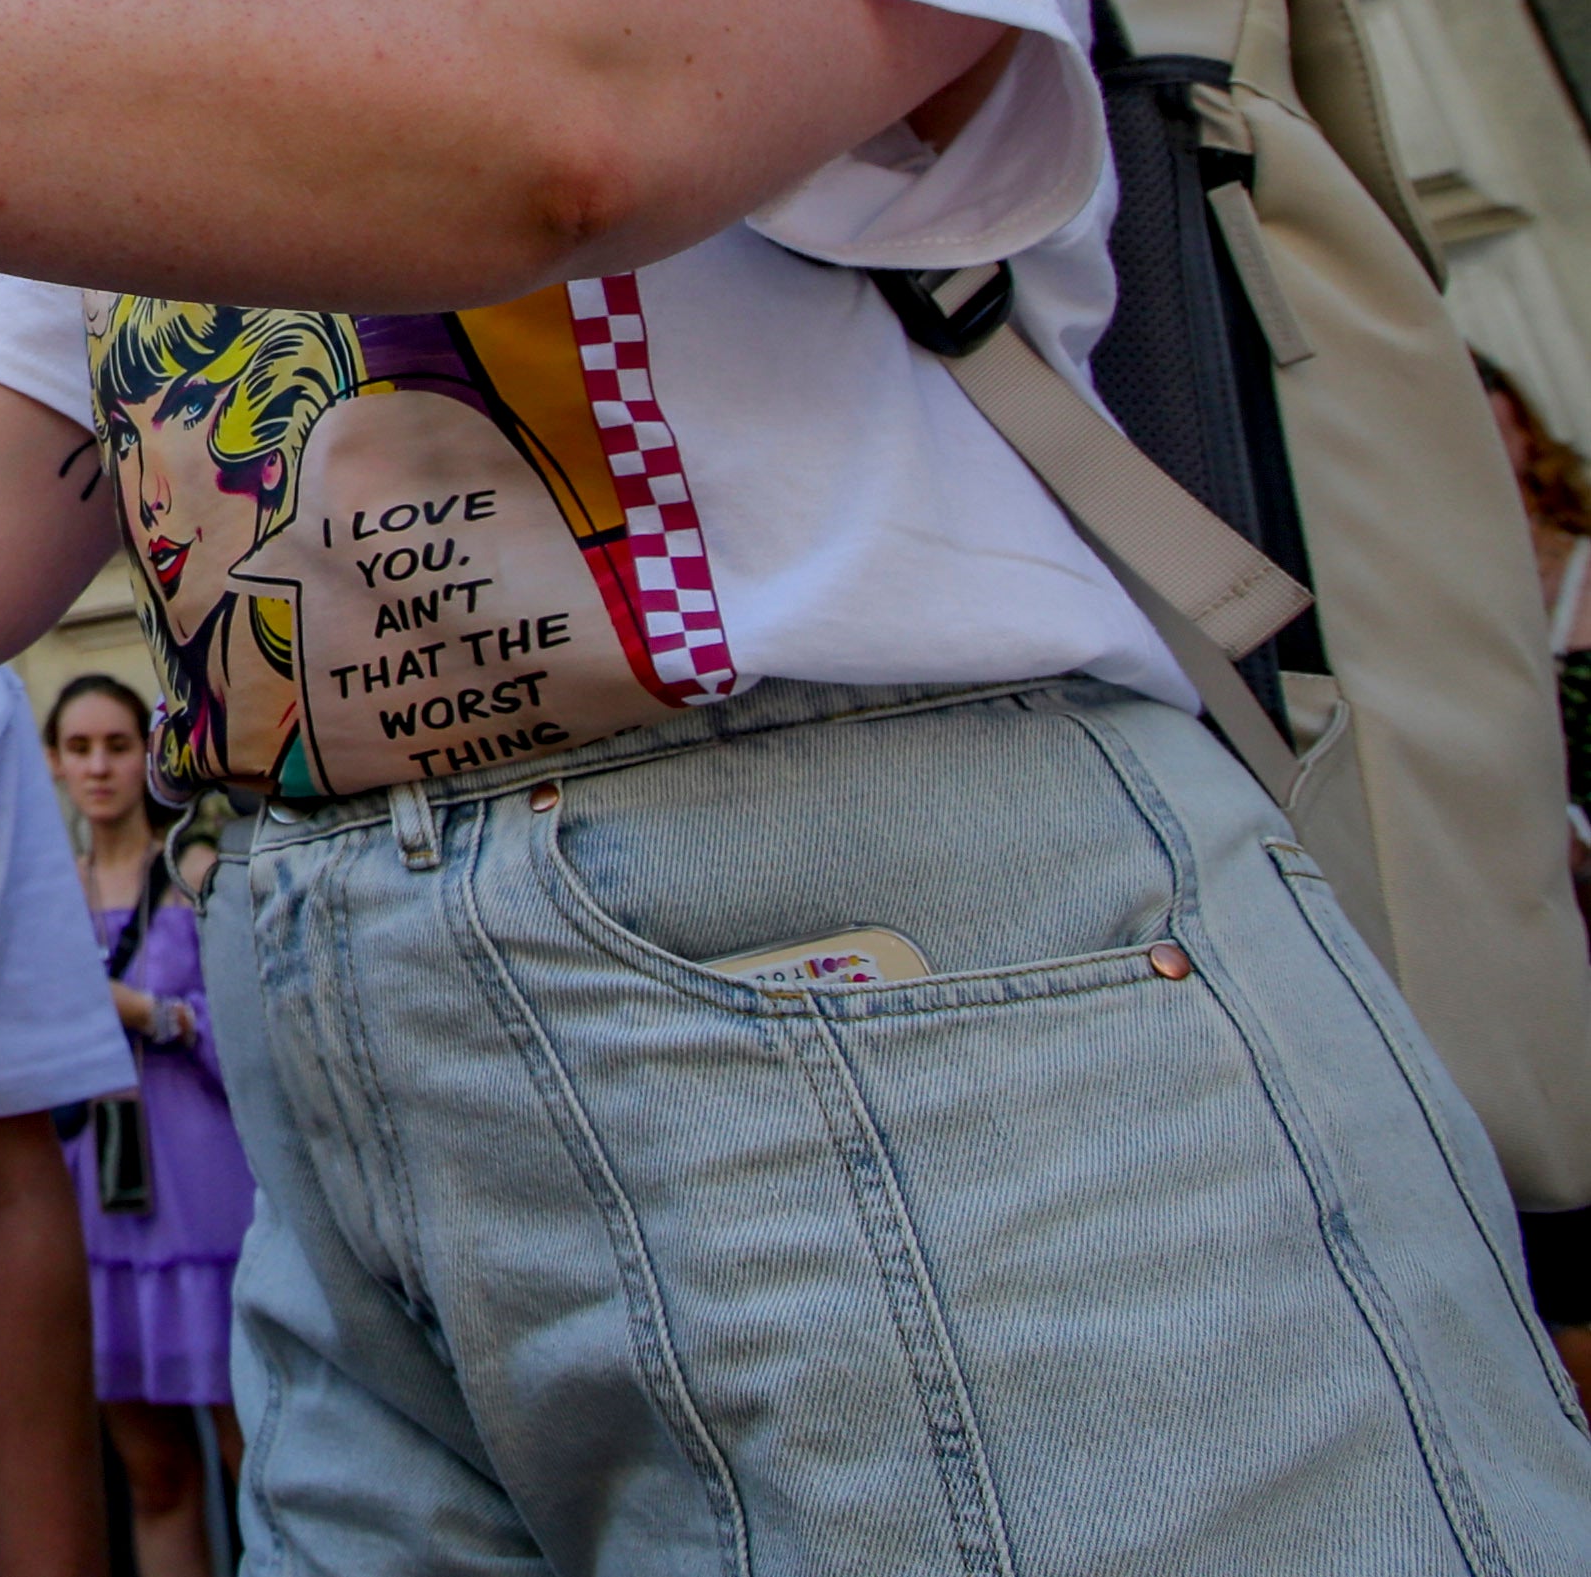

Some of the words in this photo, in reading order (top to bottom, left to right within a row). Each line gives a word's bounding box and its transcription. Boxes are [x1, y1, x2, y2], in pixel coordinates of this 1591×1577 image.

[323, 518, 333, 548] I
[352, 490, 497, 540] LOVE
[373, 579, 493, 639] AIN'T
[329, 641, 446, 699] THAT
[463, 613, 571, 666] THE
[379, 672, 549, 740] WORST
[410, 722, 570, 779] THING
